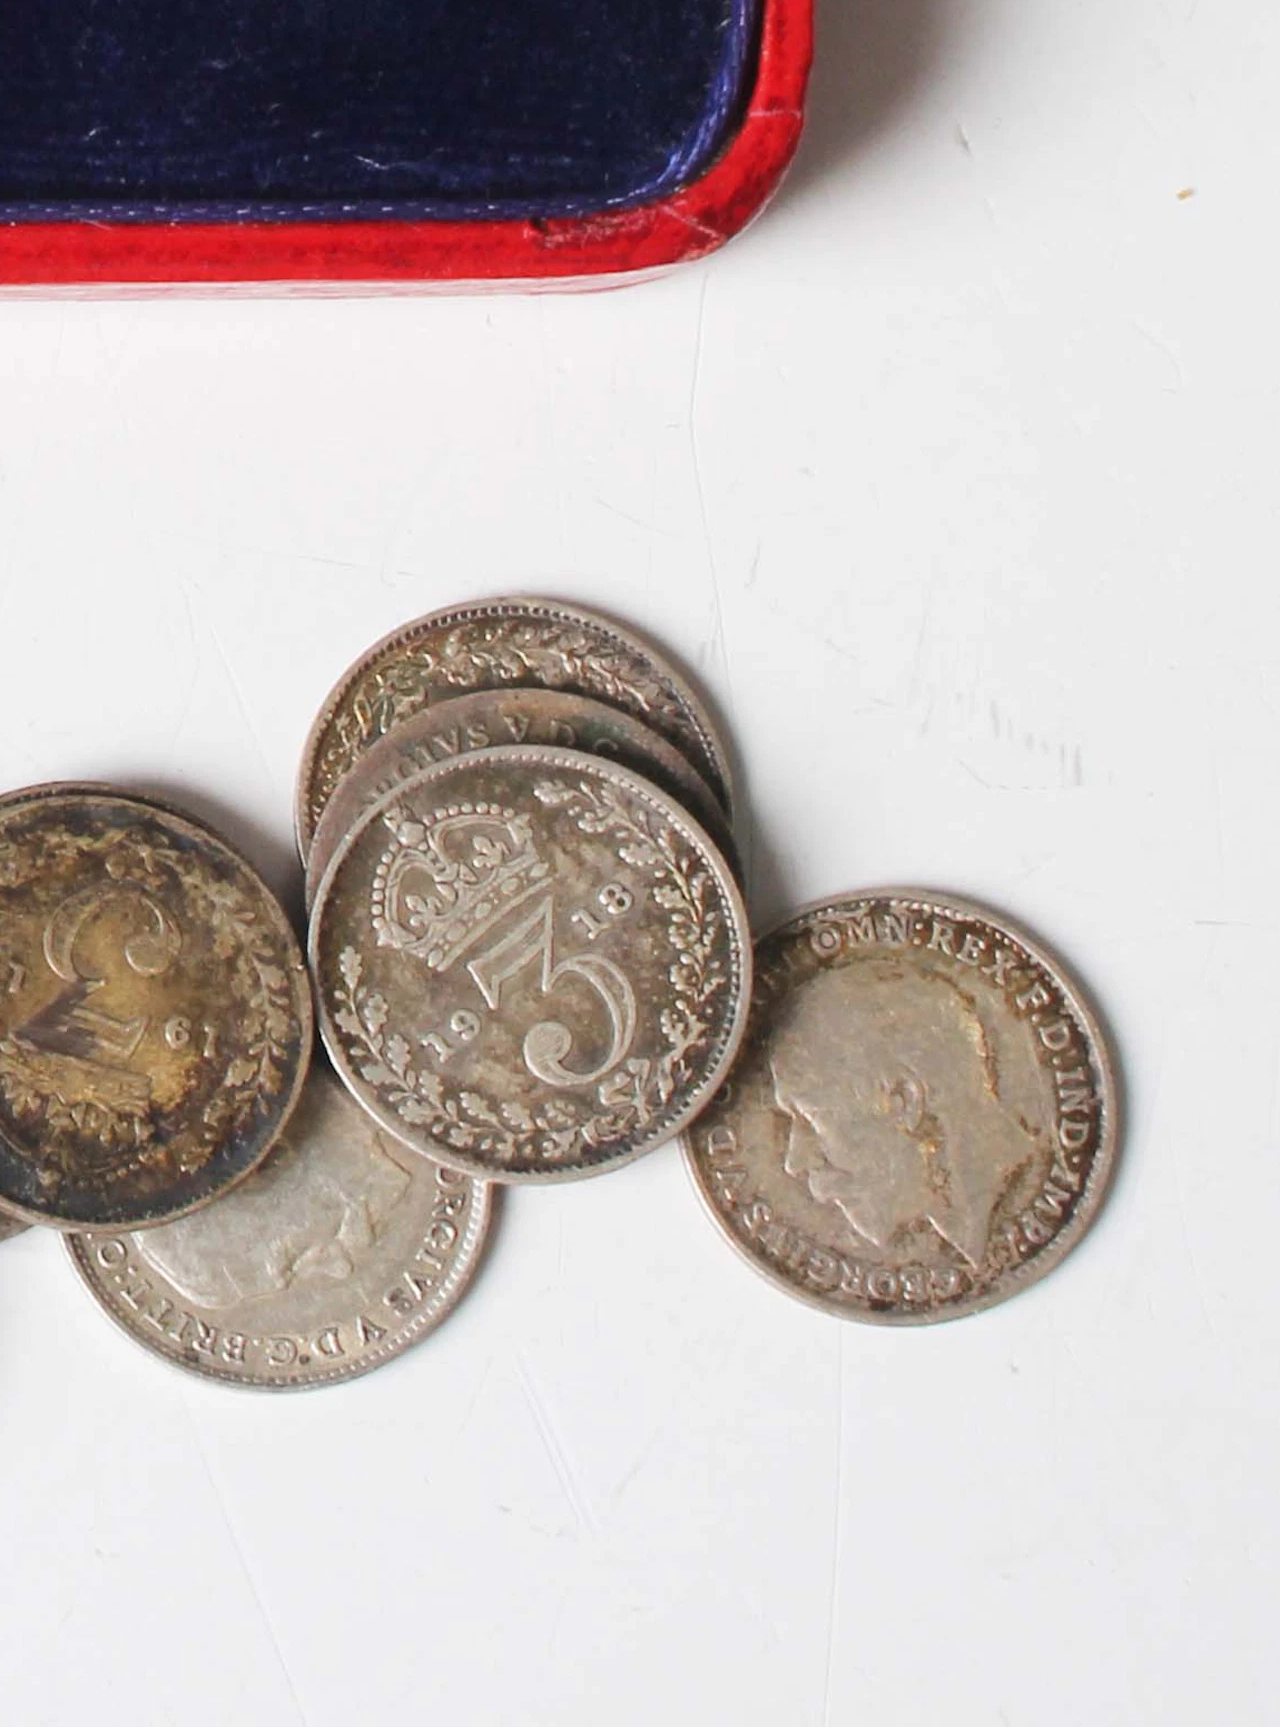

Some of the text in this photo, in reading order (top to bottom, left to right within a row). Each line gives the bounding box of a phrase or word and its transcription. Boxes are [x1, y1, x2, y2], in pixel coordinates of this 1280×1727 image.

[571, 882, 634, 940] 18
[467, 896, 637, 1085] 3
[420, 1008, 481, 1062] 19
[347, 1306, 390, 1349] V
